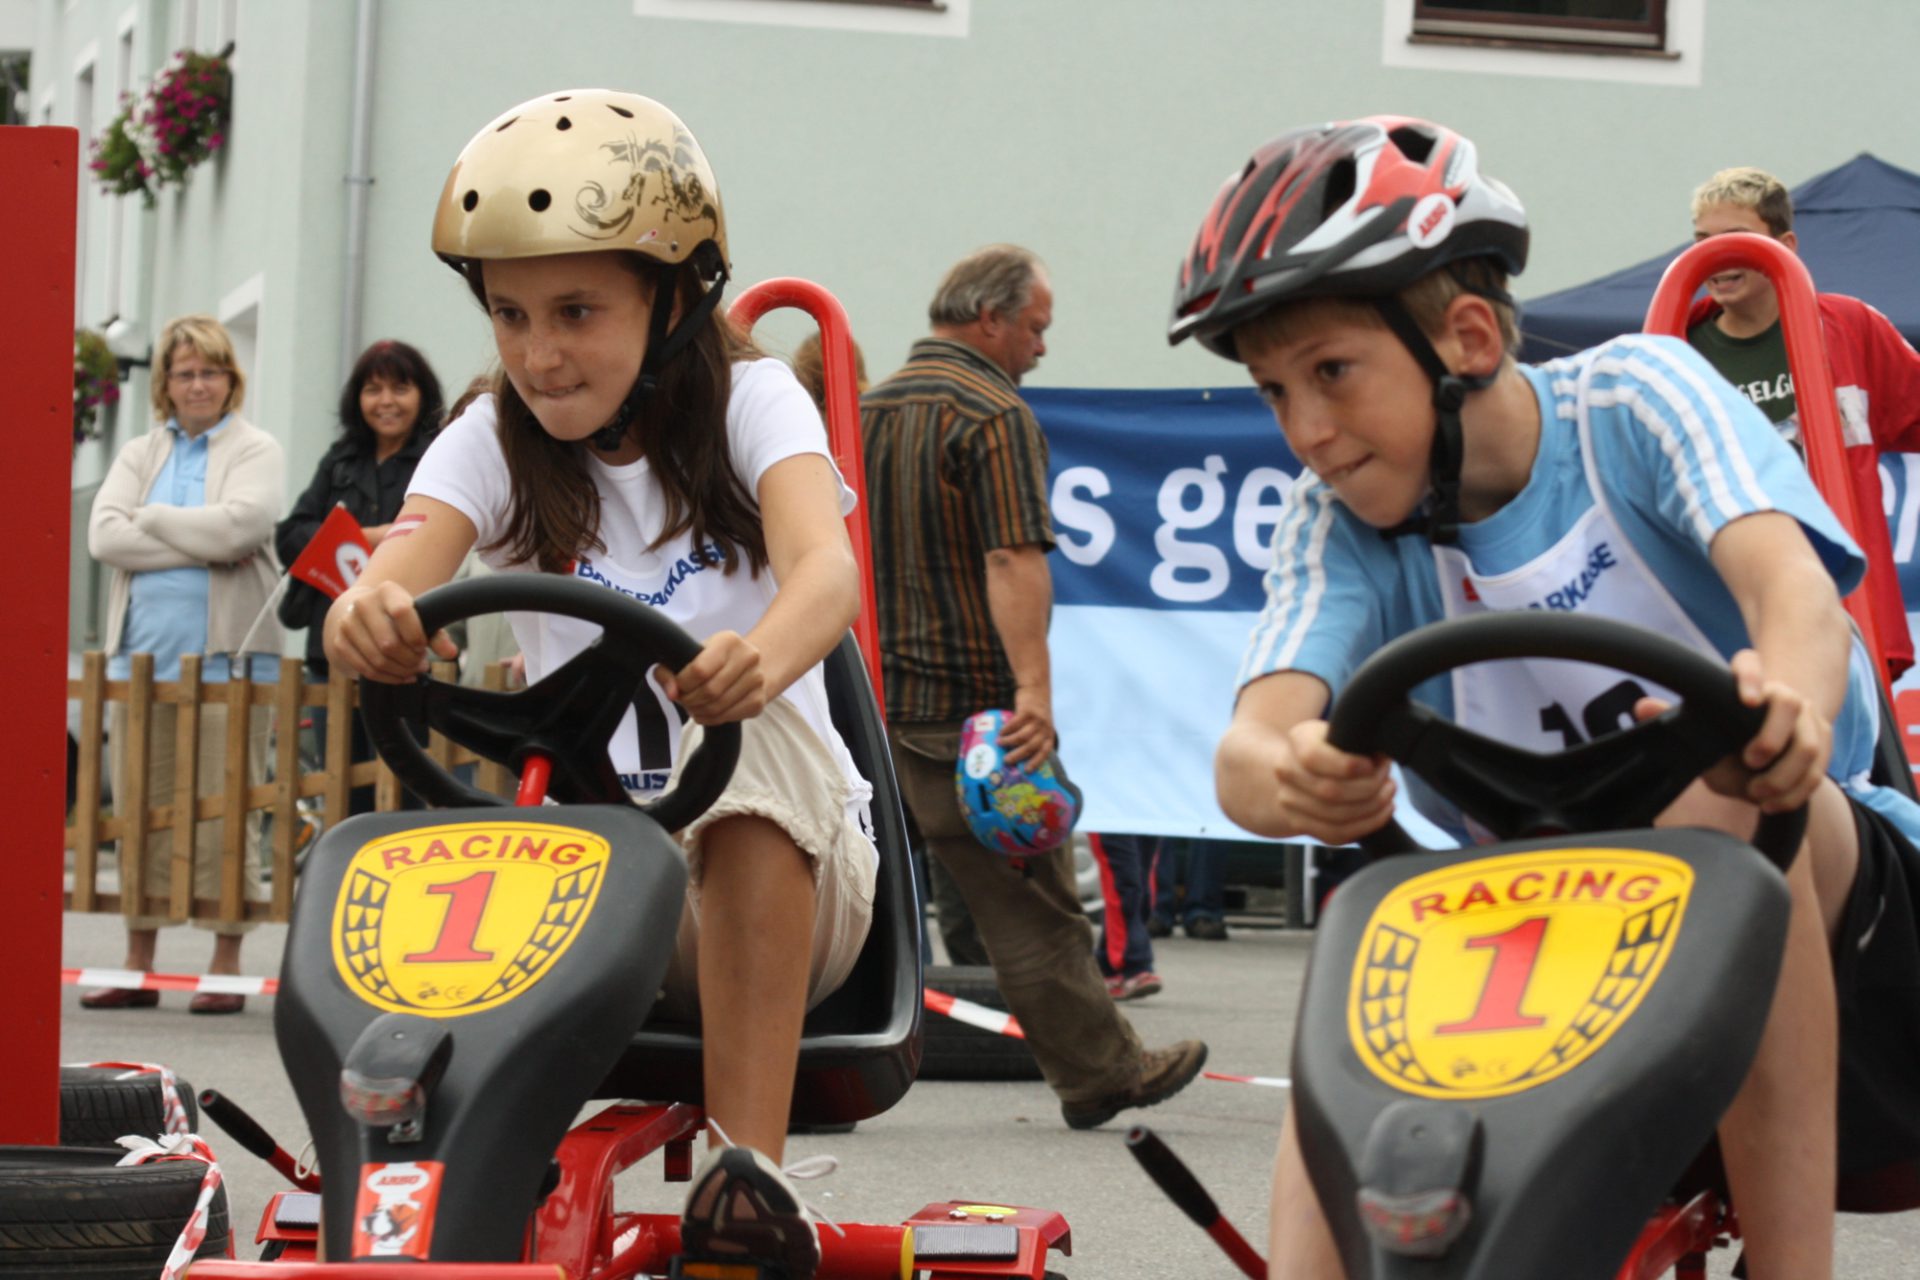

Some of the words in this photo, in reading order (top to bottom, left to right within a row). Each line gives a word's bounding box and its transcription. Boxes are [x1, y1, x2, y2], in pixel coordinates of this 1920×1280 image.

[1050, 466, 1116, 567] s
[381, 834, 587, 870] RACING
[1410, 869, 1662, 923] RACING
[403, 870, 497, 964] 1
[1433, 915, 1551, 1036] 1
